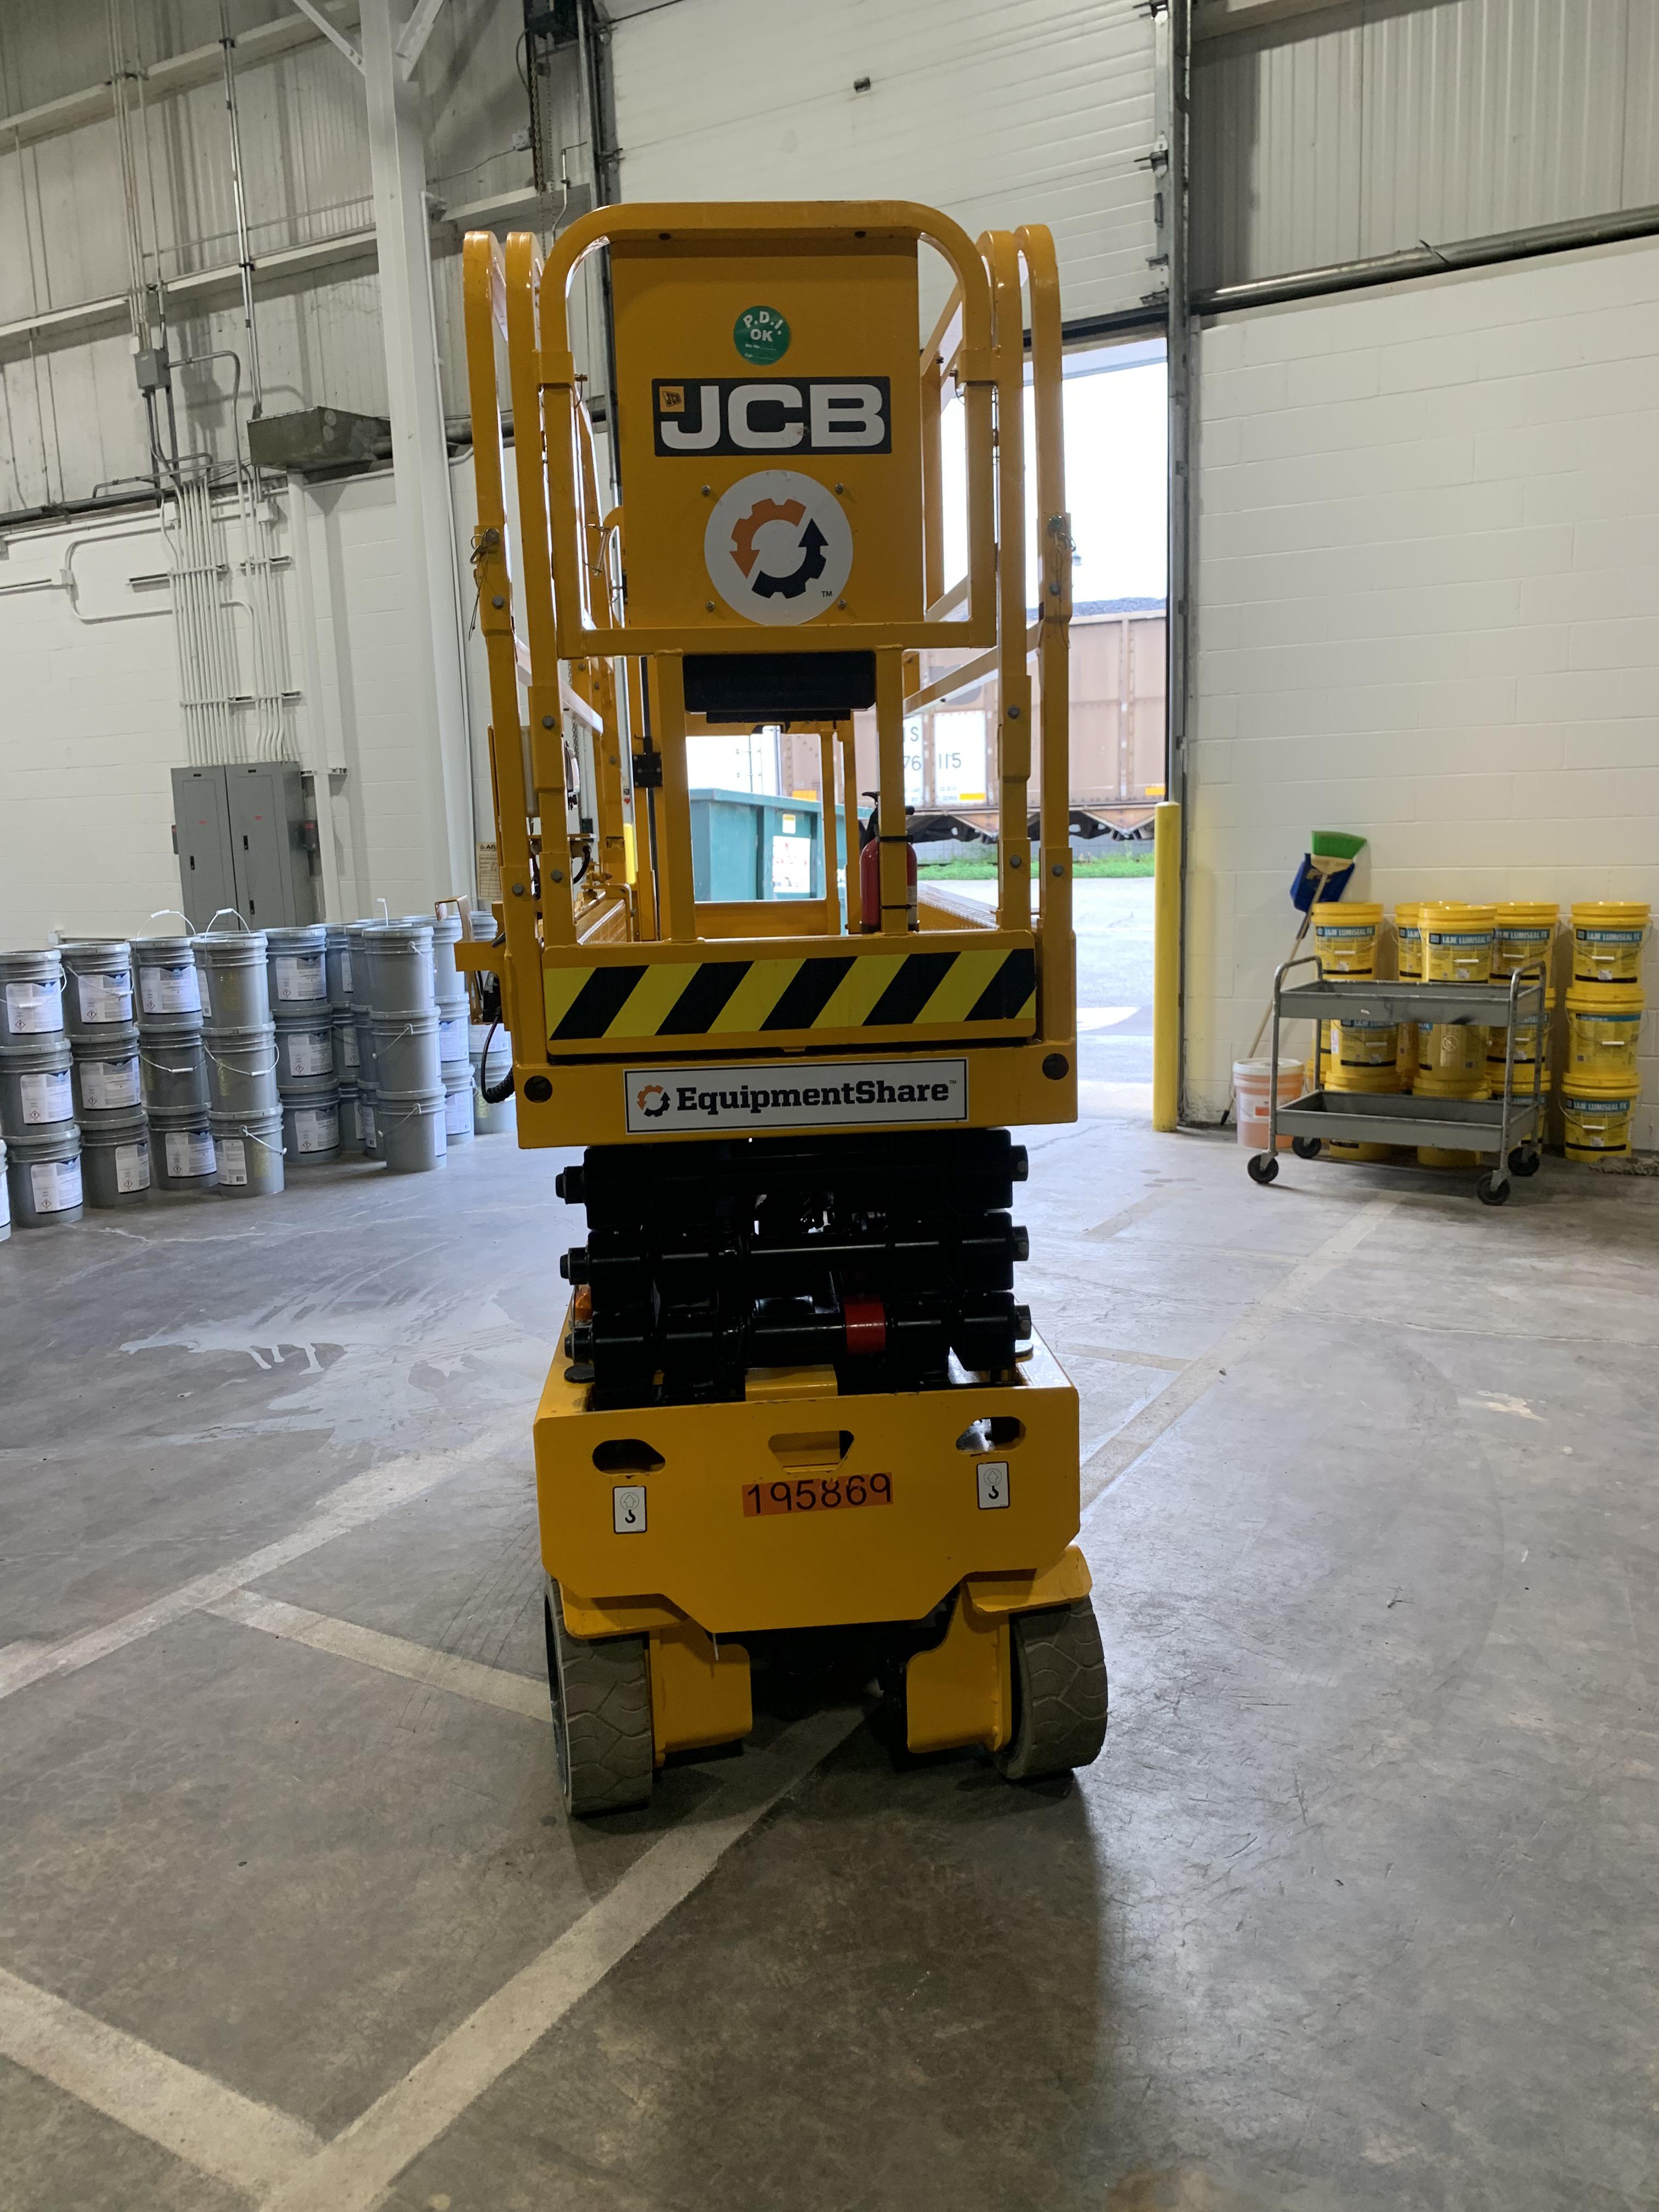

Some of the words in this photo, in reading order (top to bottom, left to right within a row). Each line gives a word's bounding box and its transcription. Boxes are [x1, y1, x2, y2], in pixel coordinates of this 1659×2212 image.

[743, 311, 783, 335] P.D.I.
[751, 329, 773, 342] OK
[661, 384, 885, 449] JCB
[939, 752, 962, 769] 115
[676, 1080, 949, 1115] EquipmentShare
[748, 1473, 891, 1514] 195869
